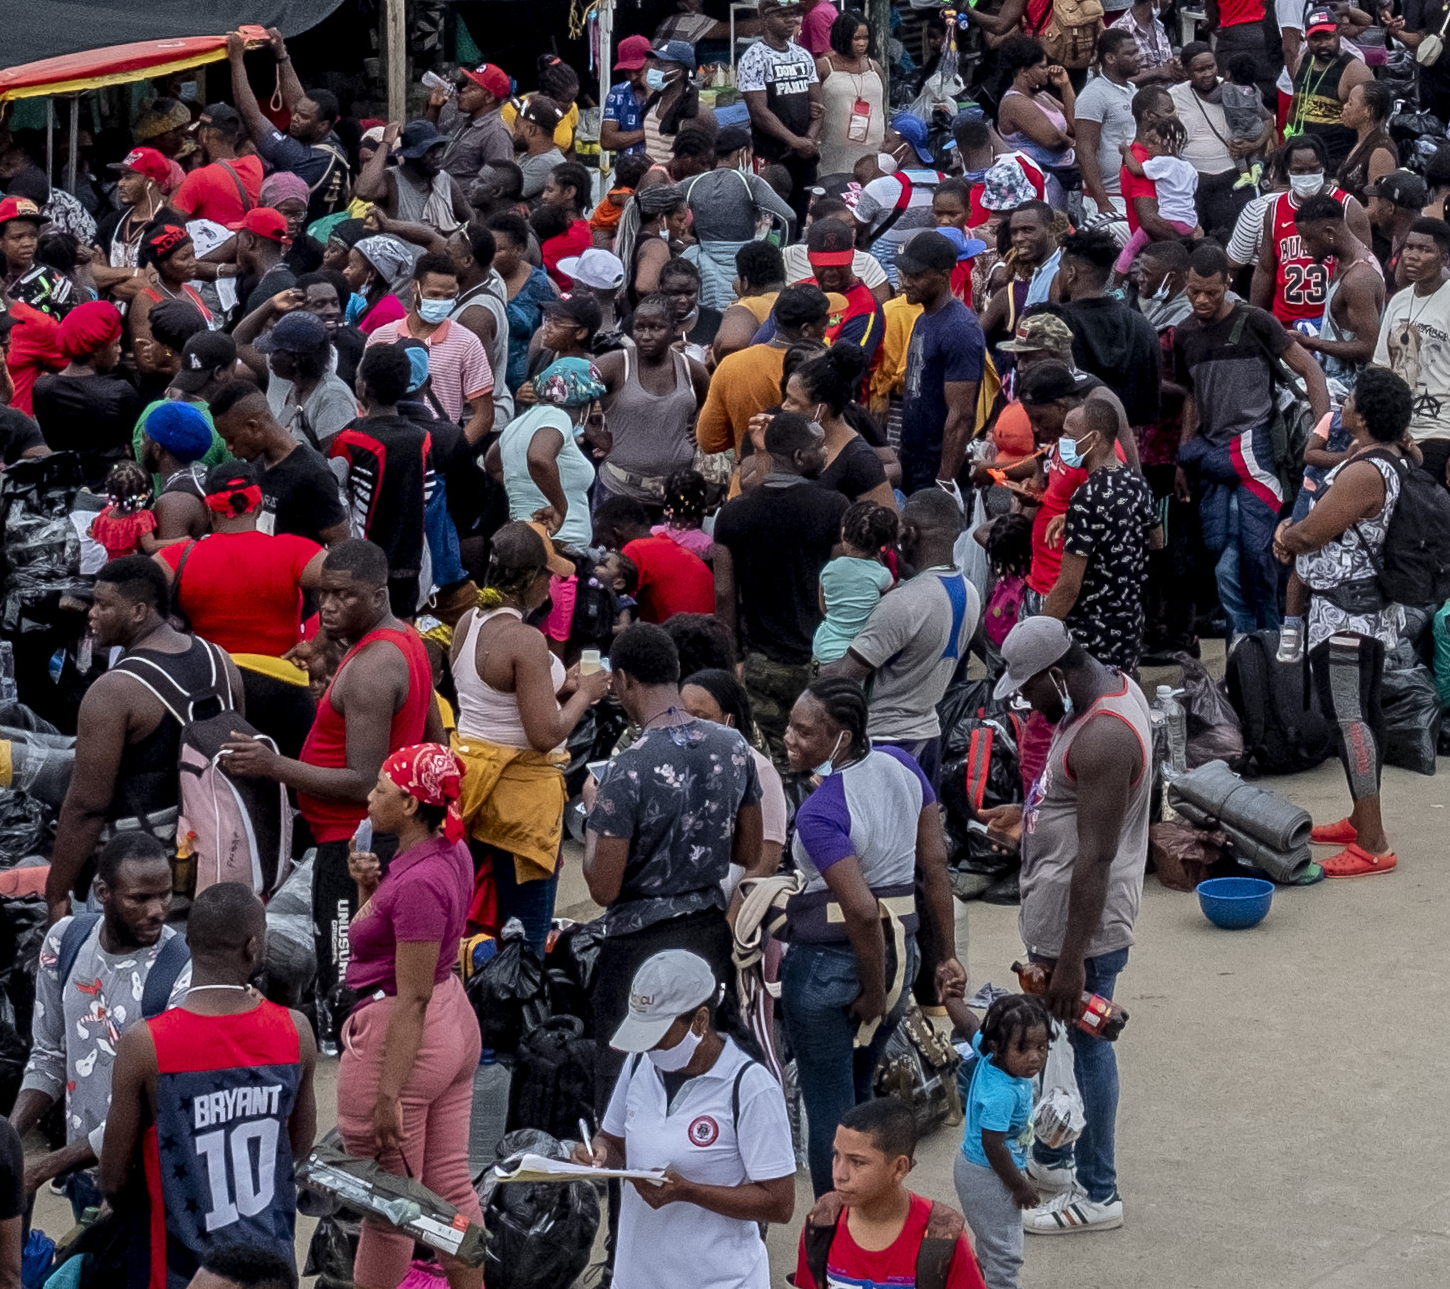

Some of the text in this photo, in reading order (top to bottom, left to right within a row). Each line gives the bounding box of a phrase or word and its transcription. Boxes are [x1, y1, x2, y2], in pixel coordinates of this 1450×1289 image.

[1284, 264, 1329, 305] 23
[193, 1084, 283, 1129] BRYANT
[195, 1117, 280, 1232] 10
